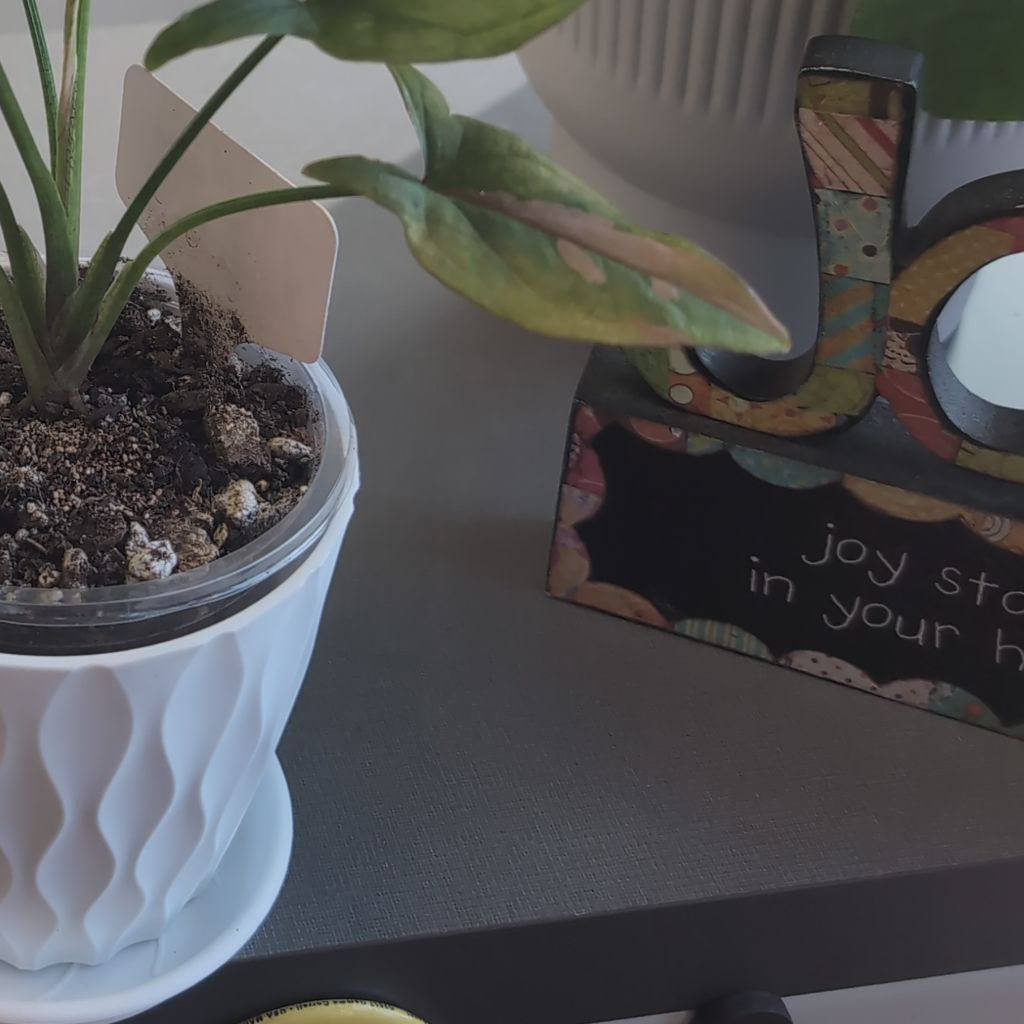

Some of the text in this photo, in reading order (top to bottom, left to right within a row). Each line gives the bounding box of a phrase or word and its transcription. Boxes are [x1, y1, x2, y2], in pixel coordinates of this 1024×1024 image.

[800, 522, 908, 588] joy
[749, 554, 796, 603] in
[822, 592, 961, 649] your
